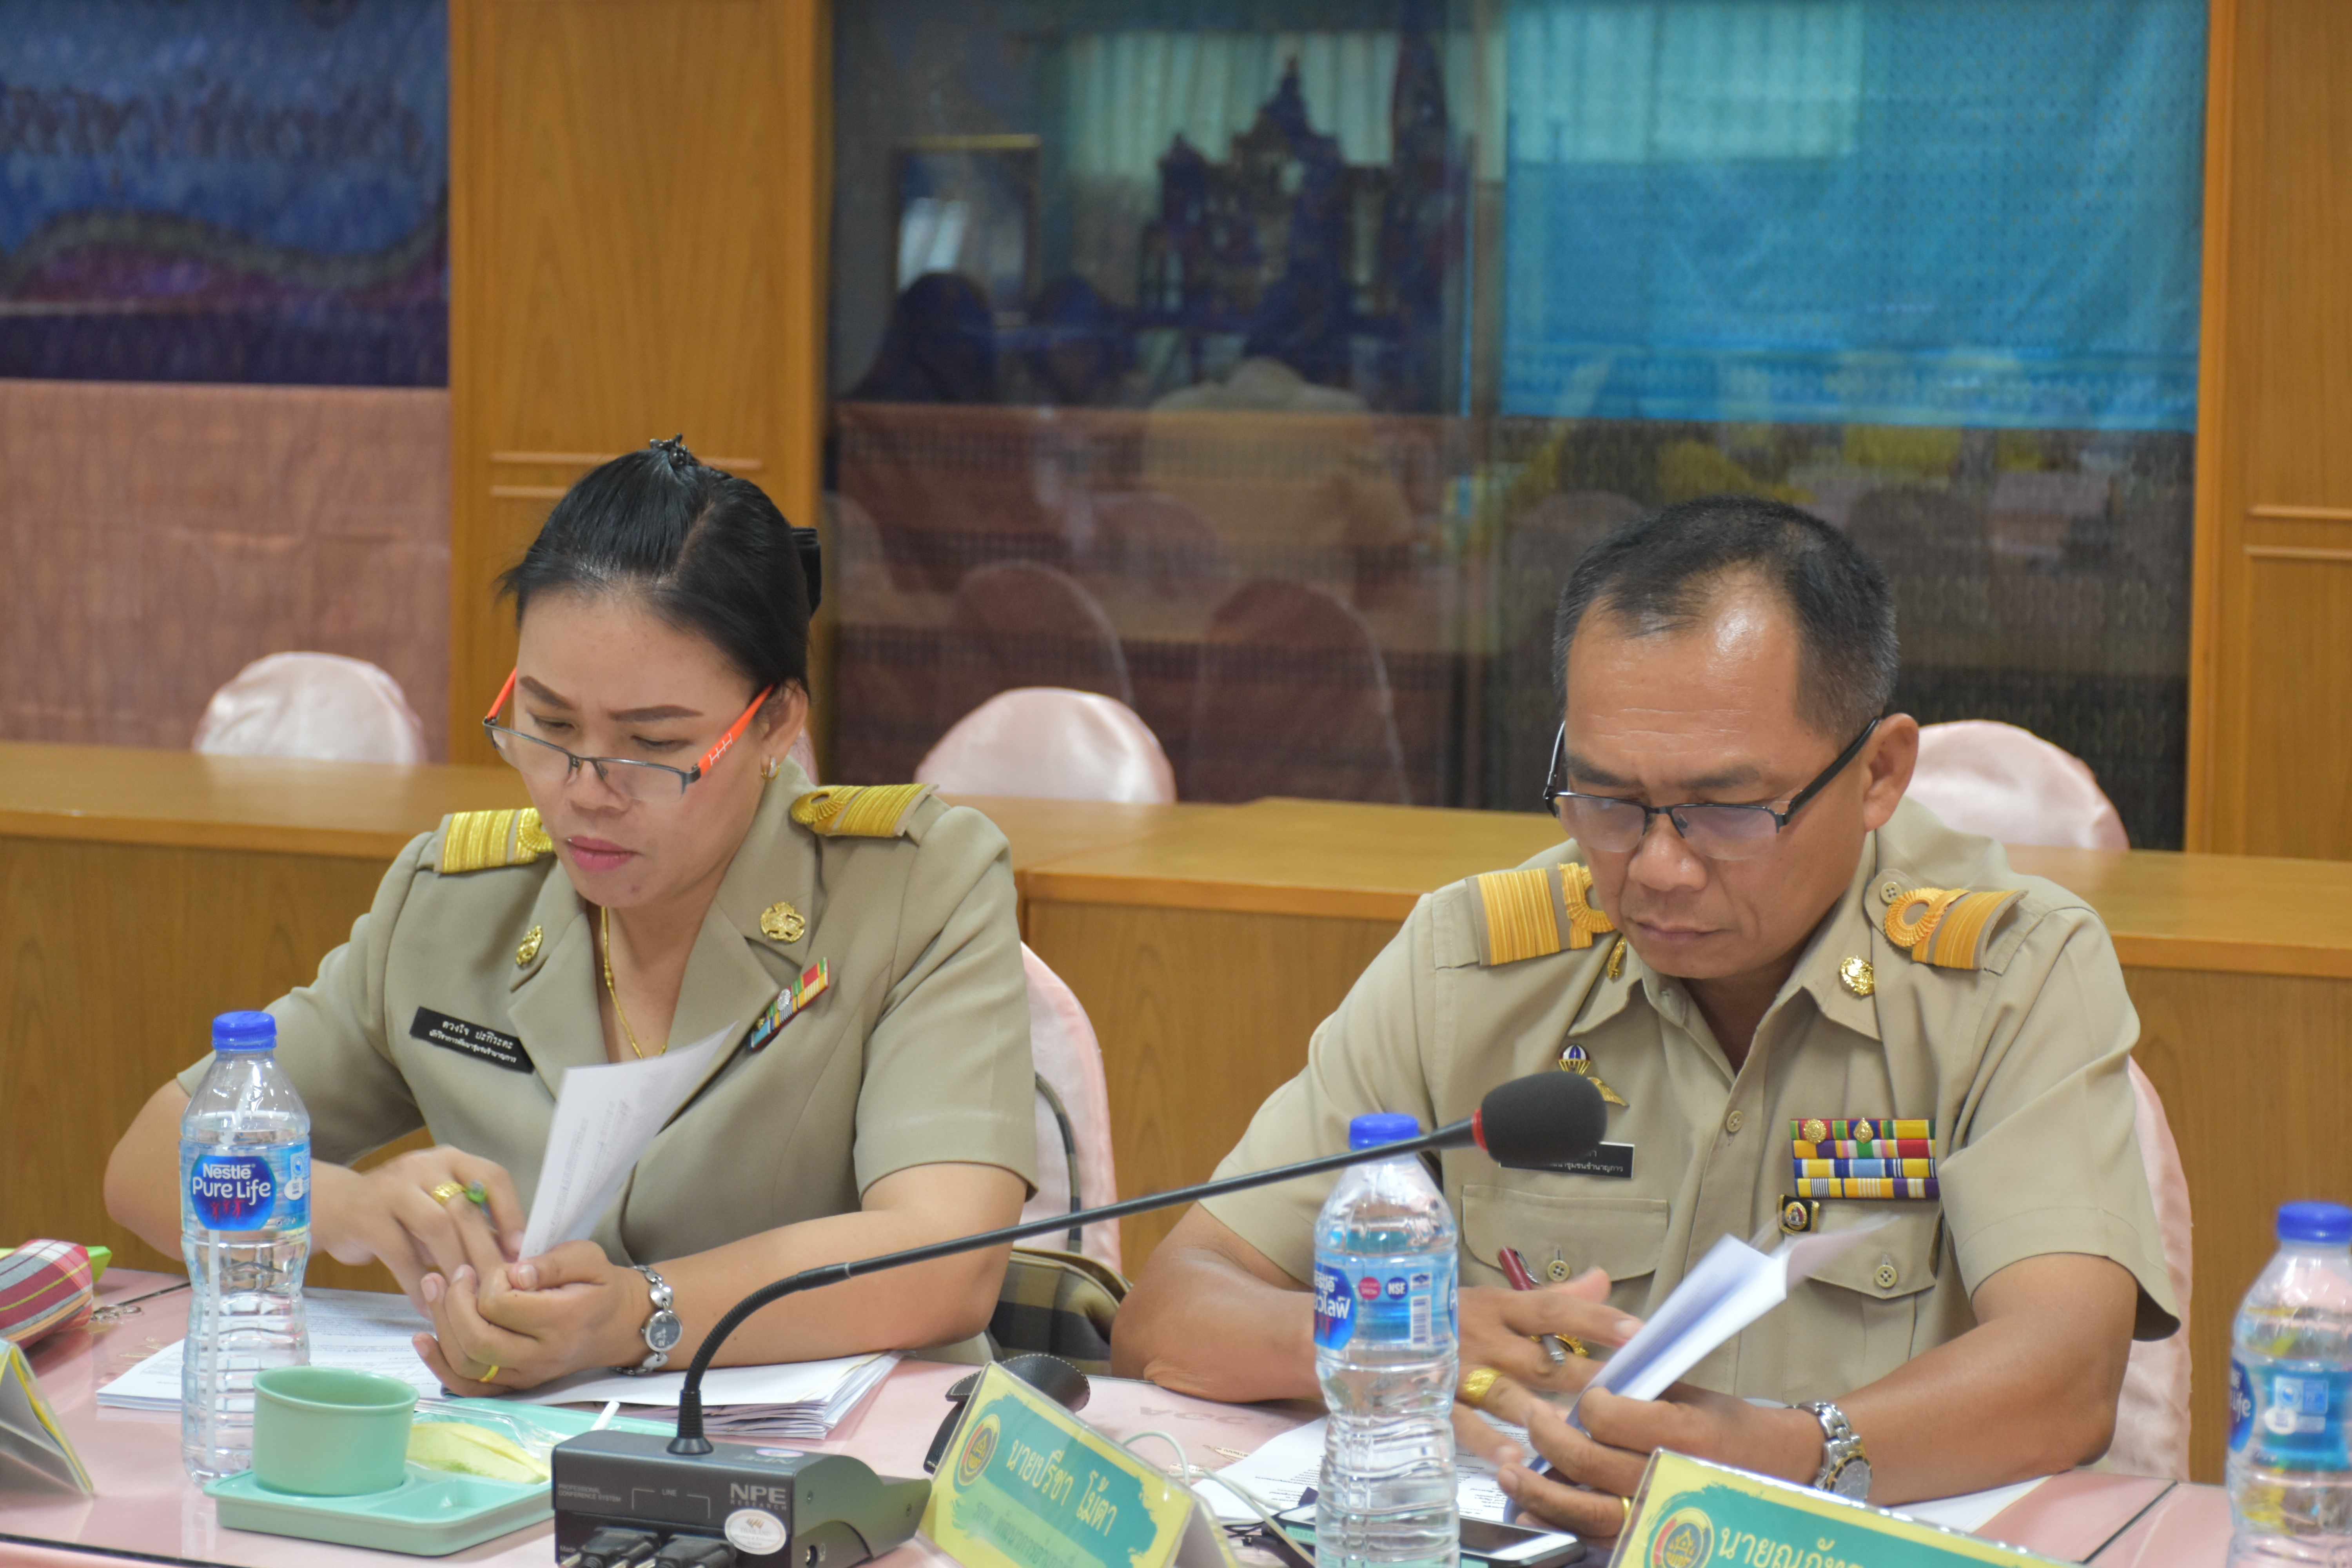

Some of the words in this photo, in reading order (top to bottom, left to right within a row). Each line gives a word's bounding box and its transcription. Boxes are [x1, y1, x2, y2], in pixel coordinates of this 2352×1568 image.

[203, 1163, 251, 1180] Nestlé
[192, 1176, 233, 1198] Pure
[237, 1179, 271, 1205] Life
[1006, 1439, 1074, 1506] นายปรีชา
[558, 1490, 597, 1499] CONFERENCE
[730, 1483, 786, 1504] NPE
[730, 1499, 787, 1511] RESEARCH
